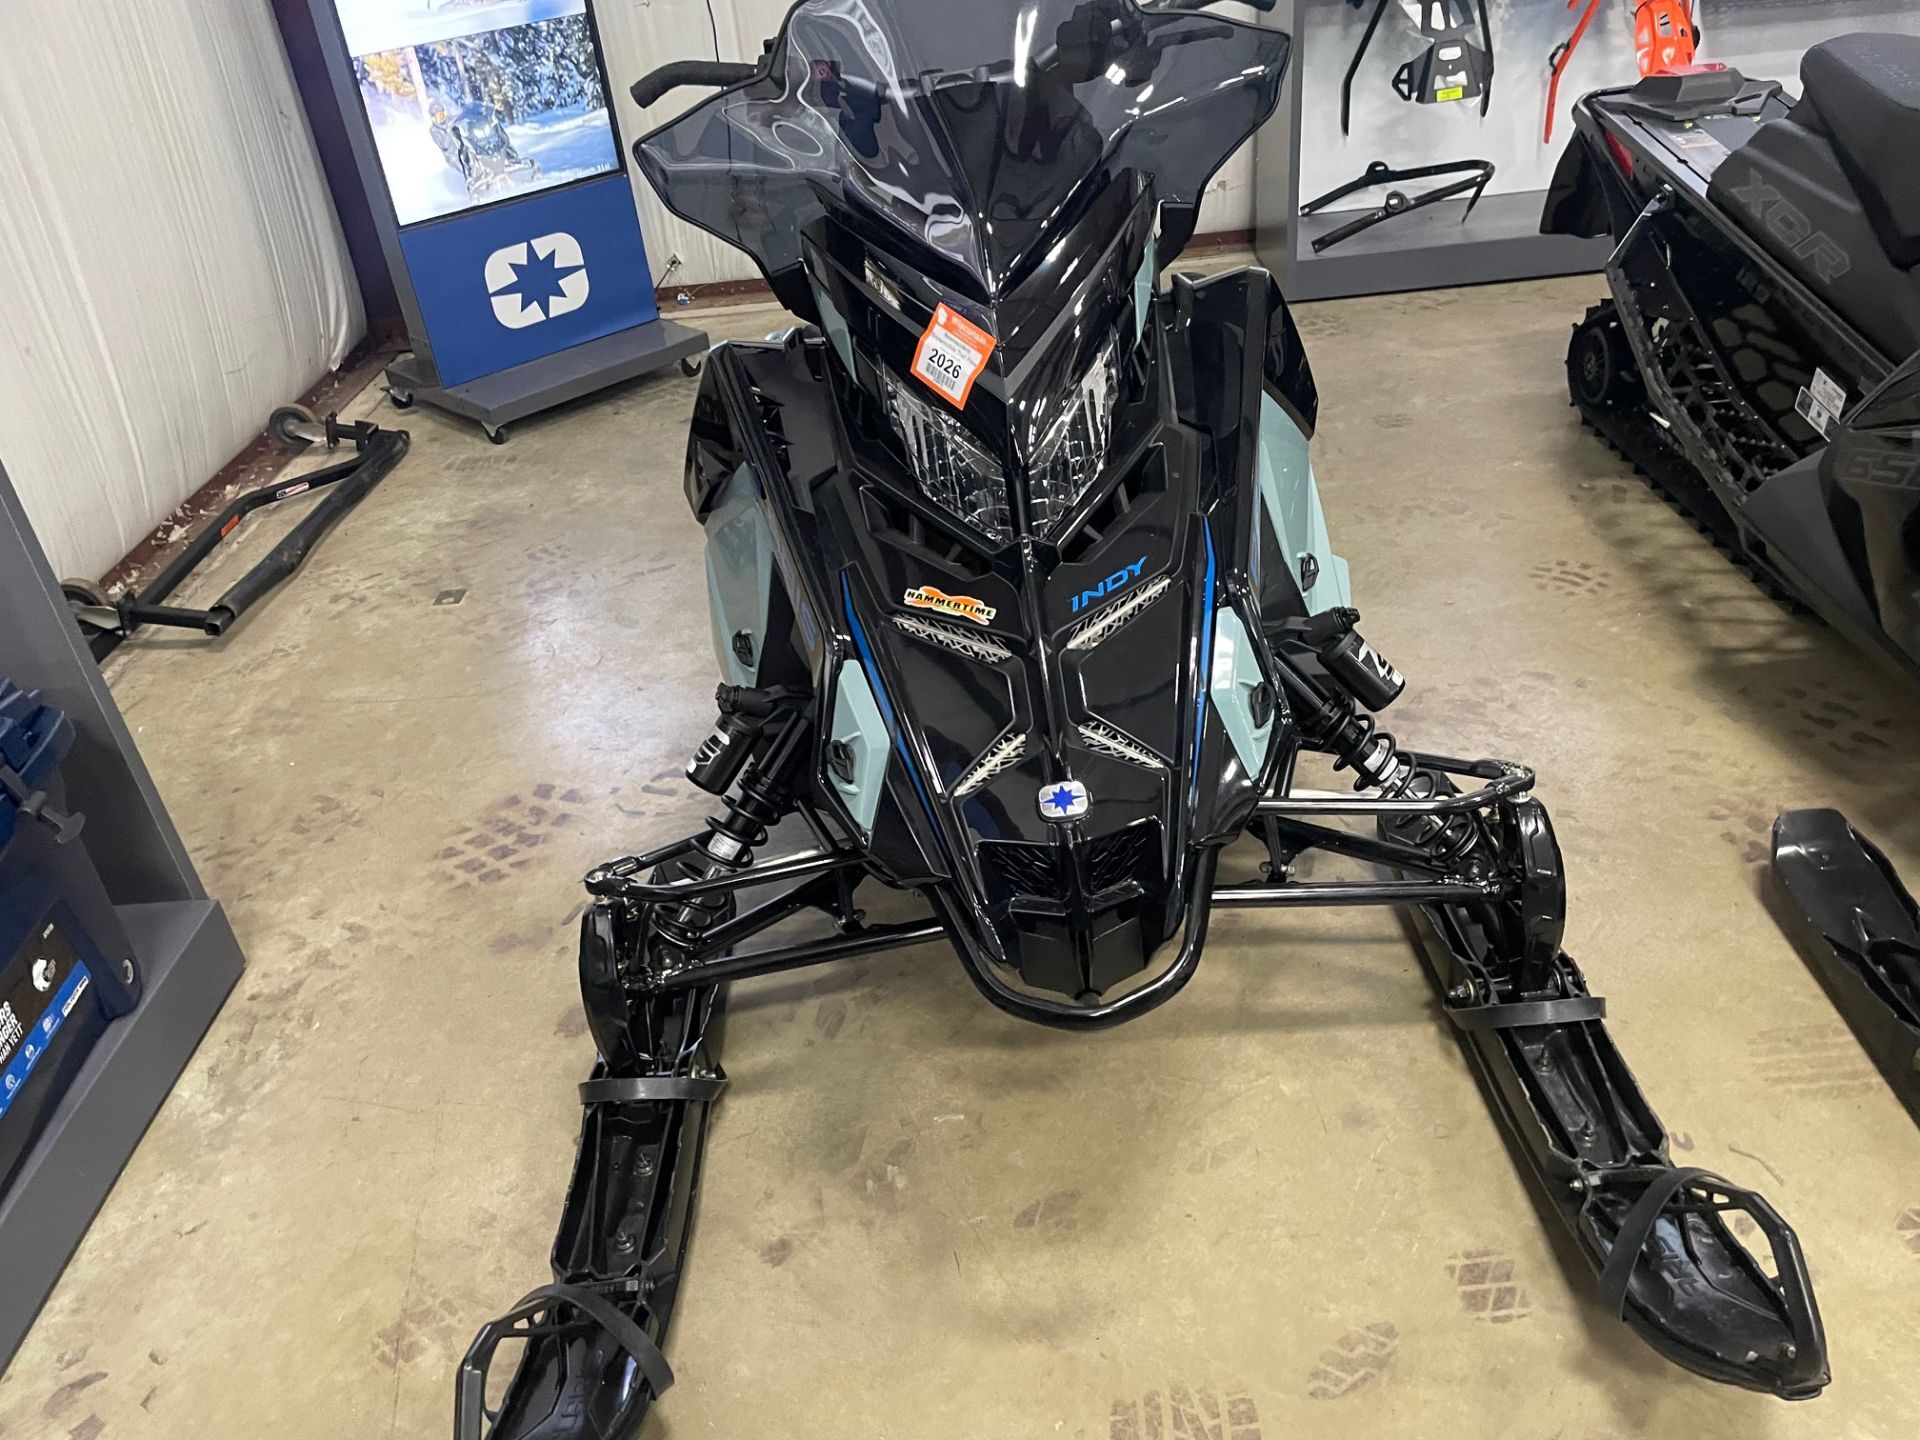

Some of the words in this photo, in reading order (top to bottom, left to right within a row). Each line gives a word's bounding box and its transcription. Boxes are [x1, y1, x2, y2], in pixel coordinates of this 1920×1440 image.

[1730, 167, 1851, 285] XCR
[928, 348, 961, 379] 2026
[1071, 555, 1147, 613] INDY
[906, 590, 994, 617] HAMMERTIME
[0, 1000, 11, 1029] RS
[0, 1012, 18, 1050] NGER
